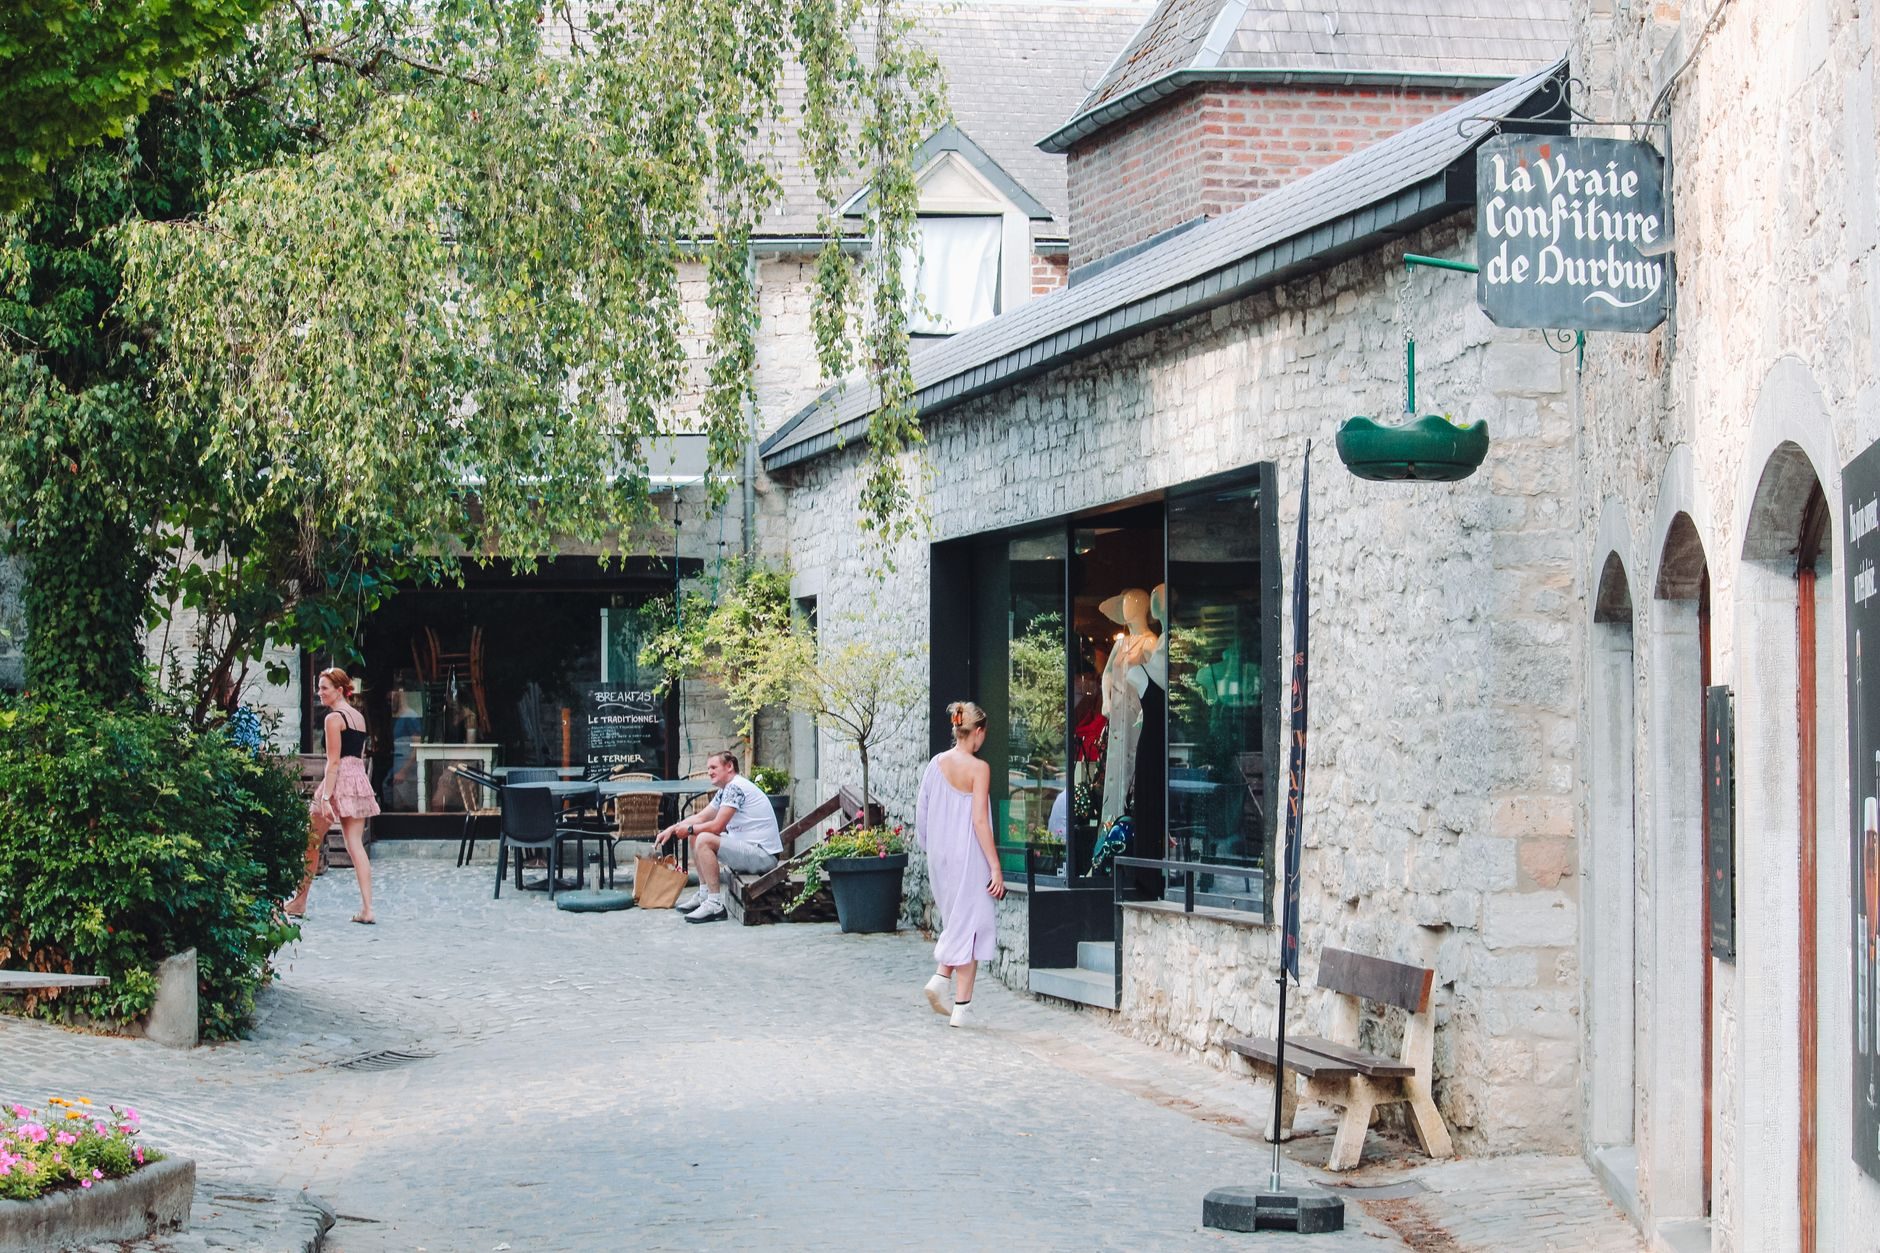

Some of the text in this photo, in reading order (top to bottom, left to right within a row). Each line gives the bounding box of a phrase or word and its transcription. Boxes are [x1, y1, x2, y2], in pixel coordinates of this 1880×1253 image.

[1533, 153, 1639, 198] Vraie
[1486, 193, 1659, 245] Confiture
[1487, 240, 1661, 307] de Durbuy
